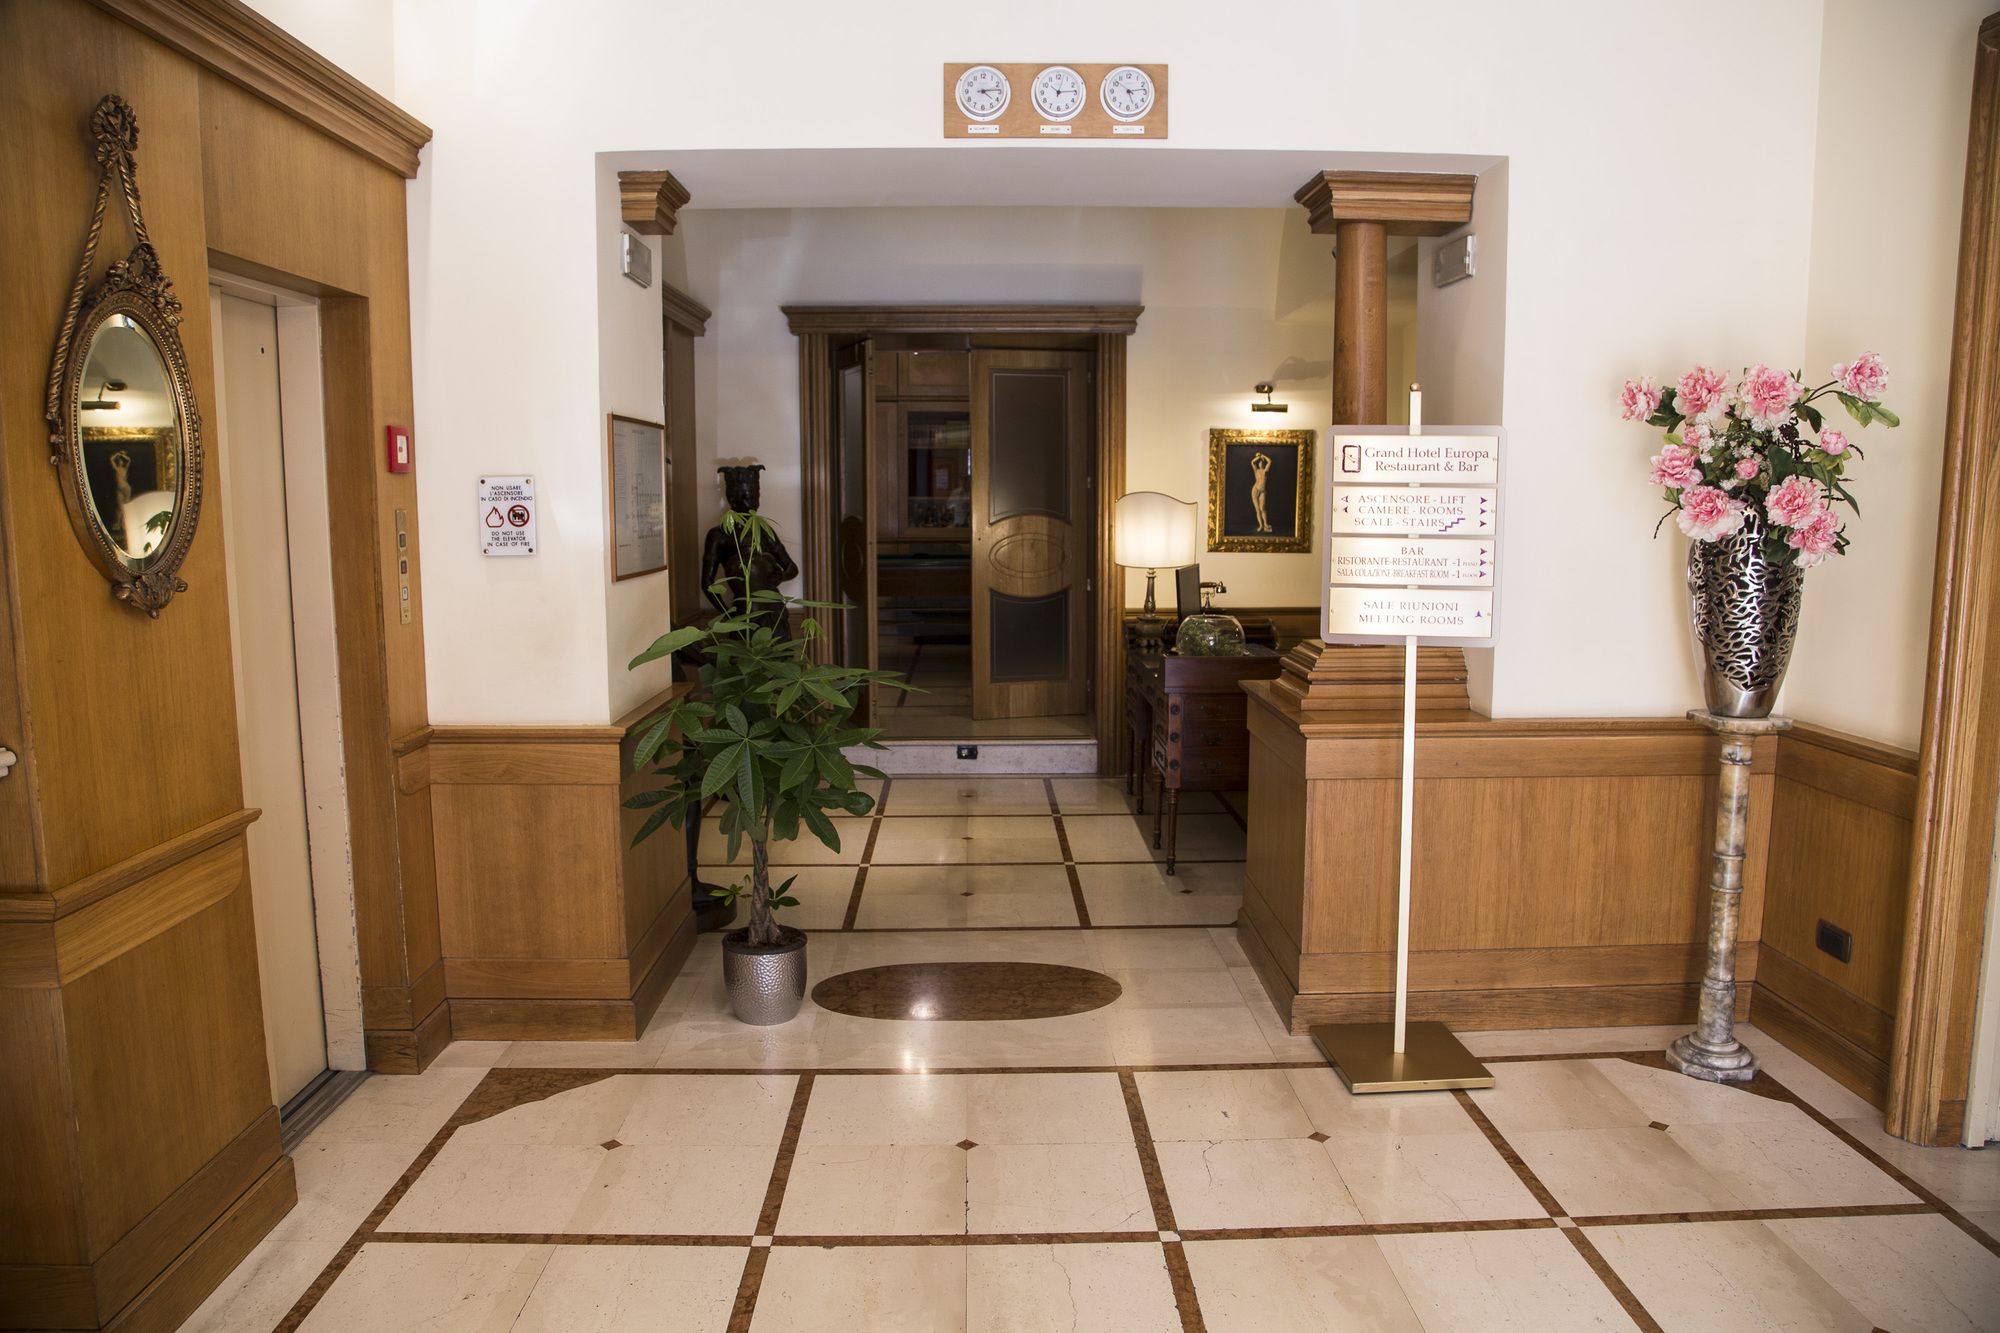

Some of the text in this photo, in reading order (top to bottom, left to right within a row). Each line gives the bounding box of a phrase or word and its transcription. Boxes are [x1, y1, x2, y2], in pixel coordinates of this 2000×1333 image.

[1364, 448, 1490, 461] Grand Hotel Europa
[1376, 461, 1480, 472] Restaurant & Bar
[1359, 495, 1432, 504] ASCENSORE
[1440, 496, 1466, 505] LIFT
[1359, 506, 1410, 515] CAMERE
[1420, 507, 1464, 515] ROOMS
[1354, 518, 1394, 527] SCALE
[1402, 518, 1445, 527] STAIRS
[1401, 547, 1424, 556] BAR
[1452, 558, 1461, 567] -1
[1337, 569, 1354, 577] SALA
[1430, 570, 1449, 579] ROOM
[1364, 601, 1459, 612] SALE RIUNIONI
[1359, 614, 1465, 625] MEETING ROOMS
